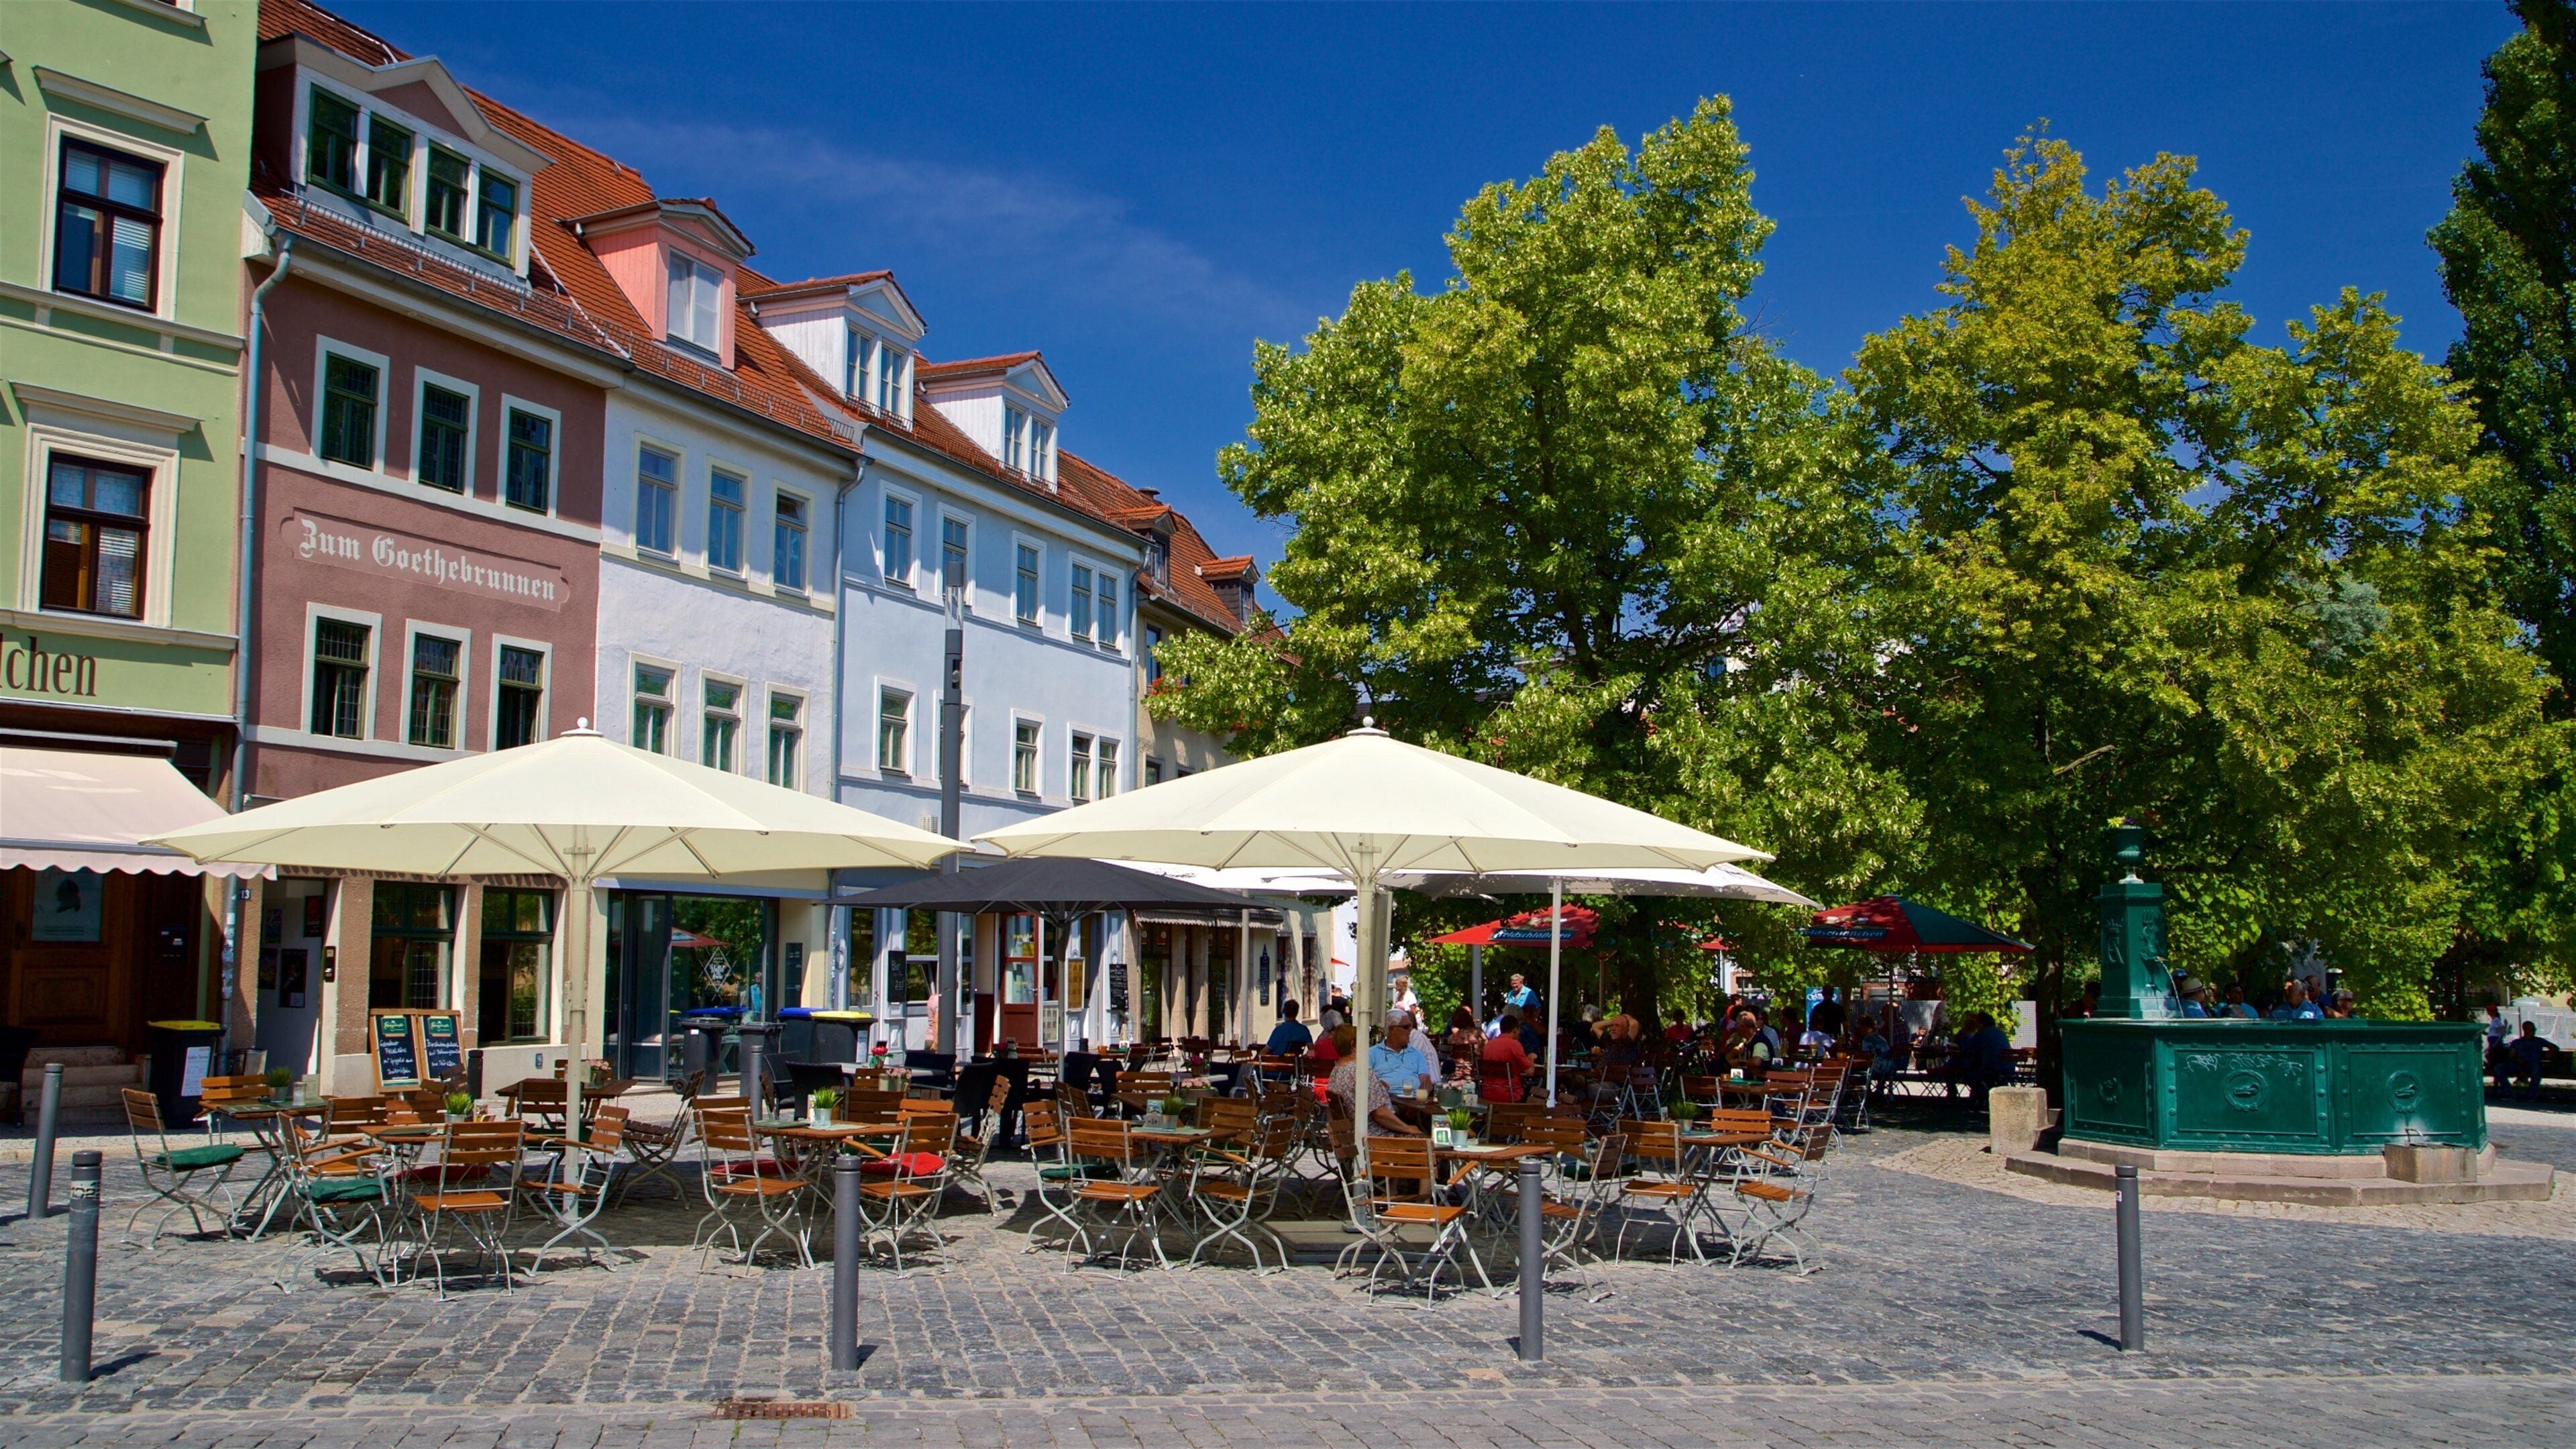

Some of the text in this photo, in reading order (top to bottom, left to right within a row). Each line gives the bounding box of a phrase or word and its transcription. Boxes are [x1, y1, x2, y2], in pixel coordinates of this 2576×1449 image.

[299, 519, 555, 600] Zum Goethebrunnen
[240, 890, 250, 900] 13
